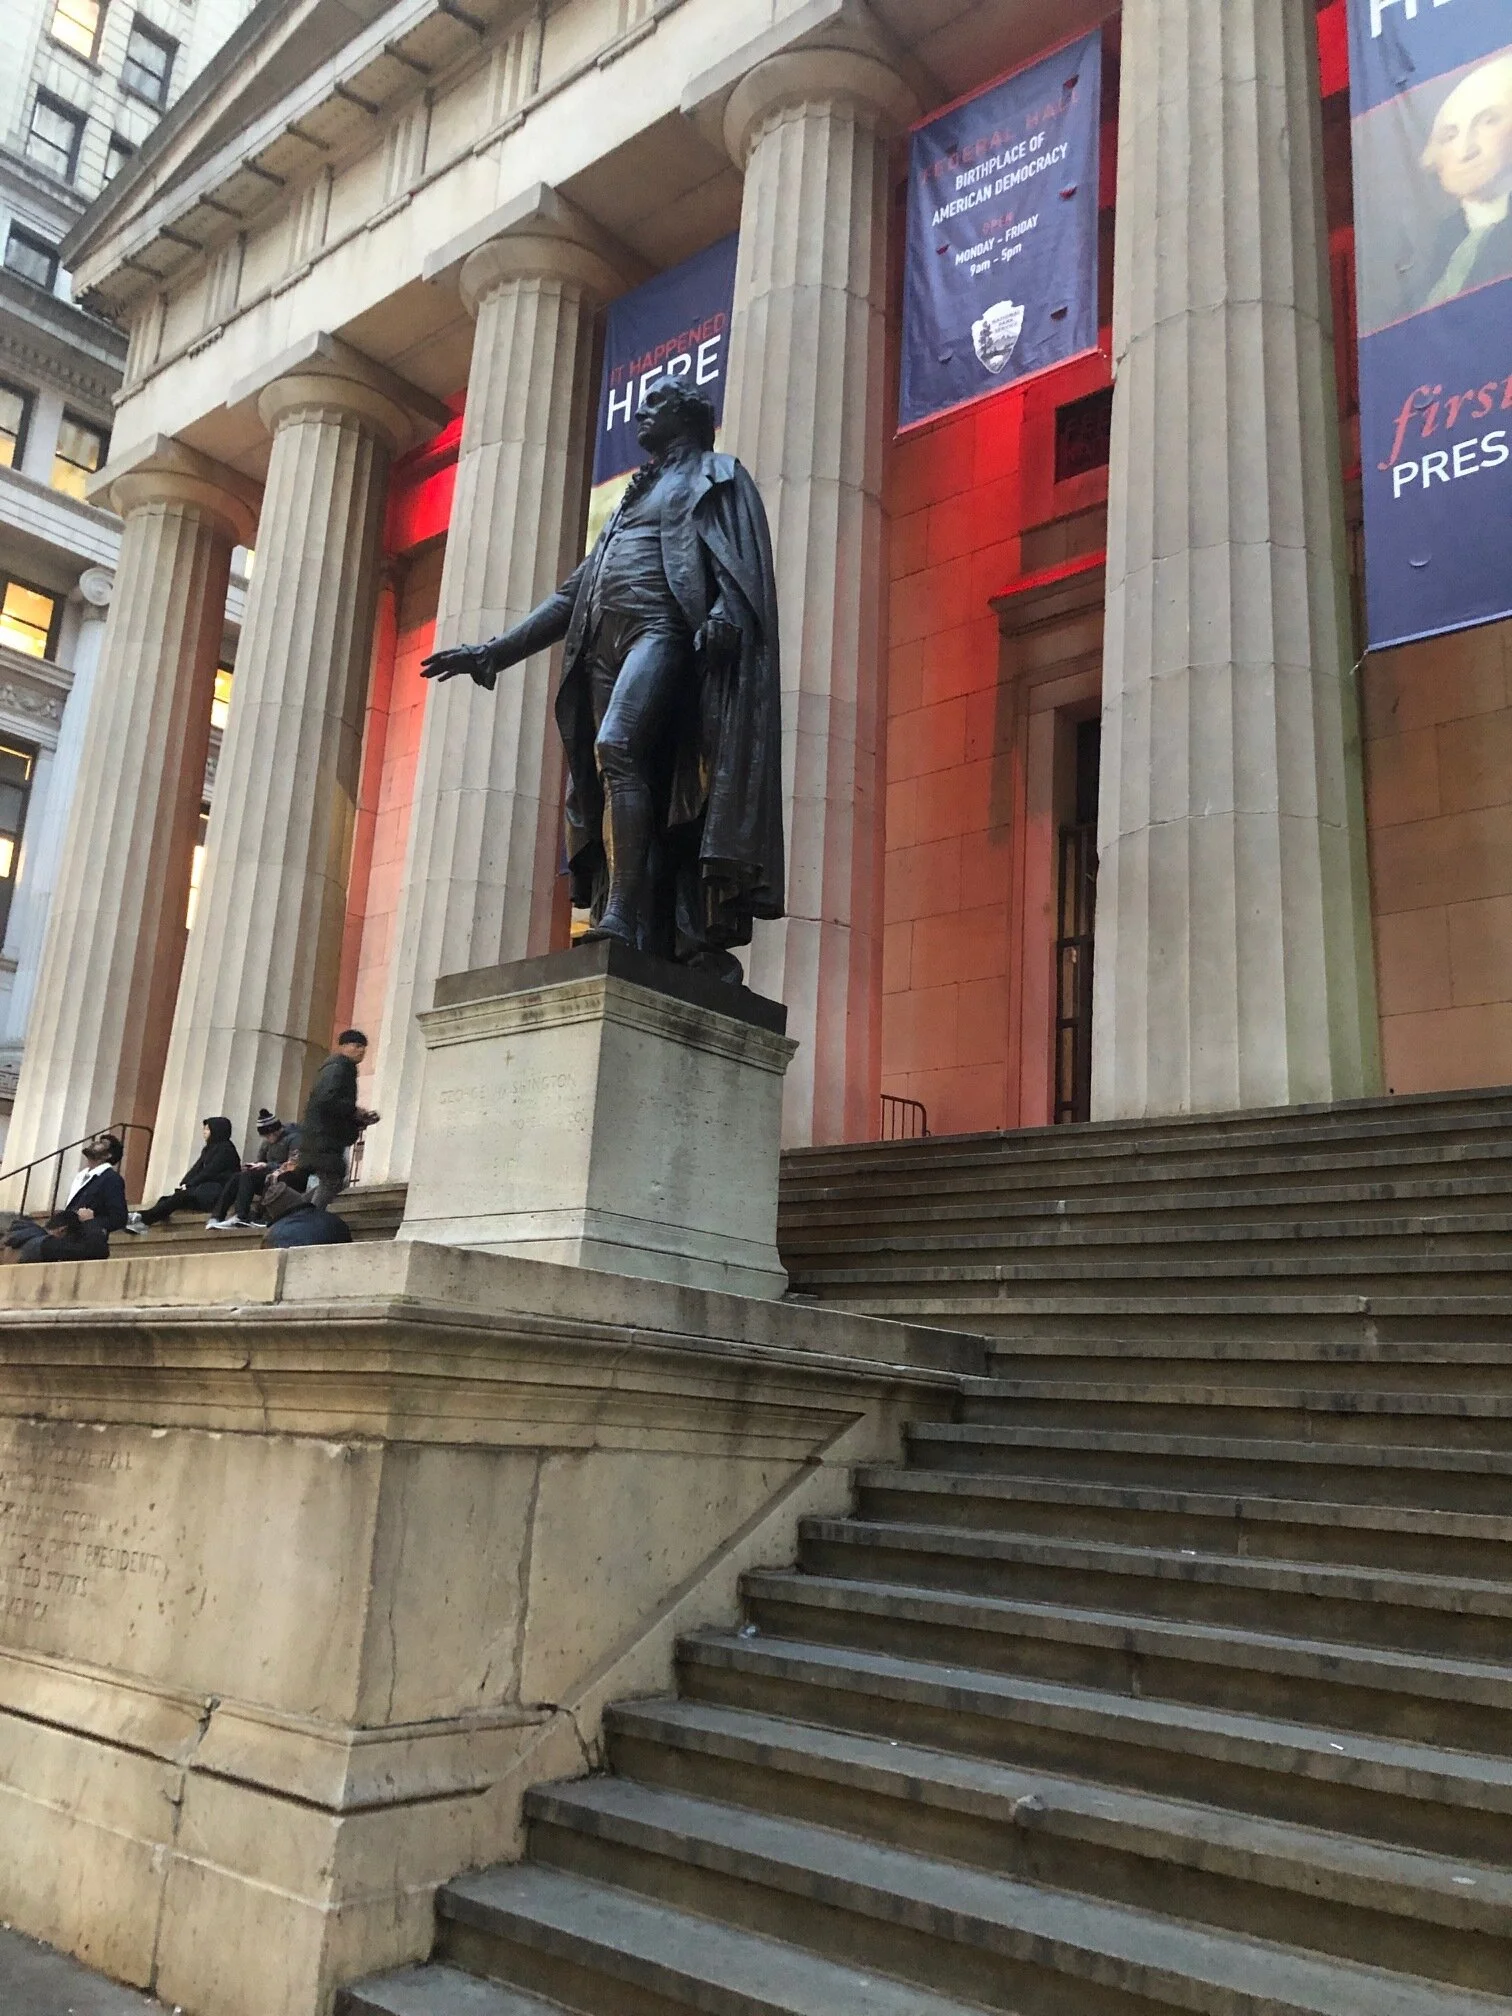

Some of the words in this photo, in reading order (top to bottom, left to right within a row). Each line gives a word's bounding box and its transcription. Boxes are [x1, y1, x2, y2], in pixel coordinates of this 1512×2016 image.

[932, 182, 993, 227] AMERICAN
[994, 142, 1069, 196] DEMOCRACY
[956, 140, 1027, 190] BIRTHPLACE
[1029, 131, 1046, 152] OF
[953, 237, 996, 267] MONDAY
[1004, 213, 1039, 242] FRIDAY
[970, 259, 991, 277] 9am
[1000, 243, 1022, 262] 5pm
[610, 364, 624, 386] IT
[629, 312, 726, 376] HAPPENED
[1392, 430, 1510, 499] PRES
